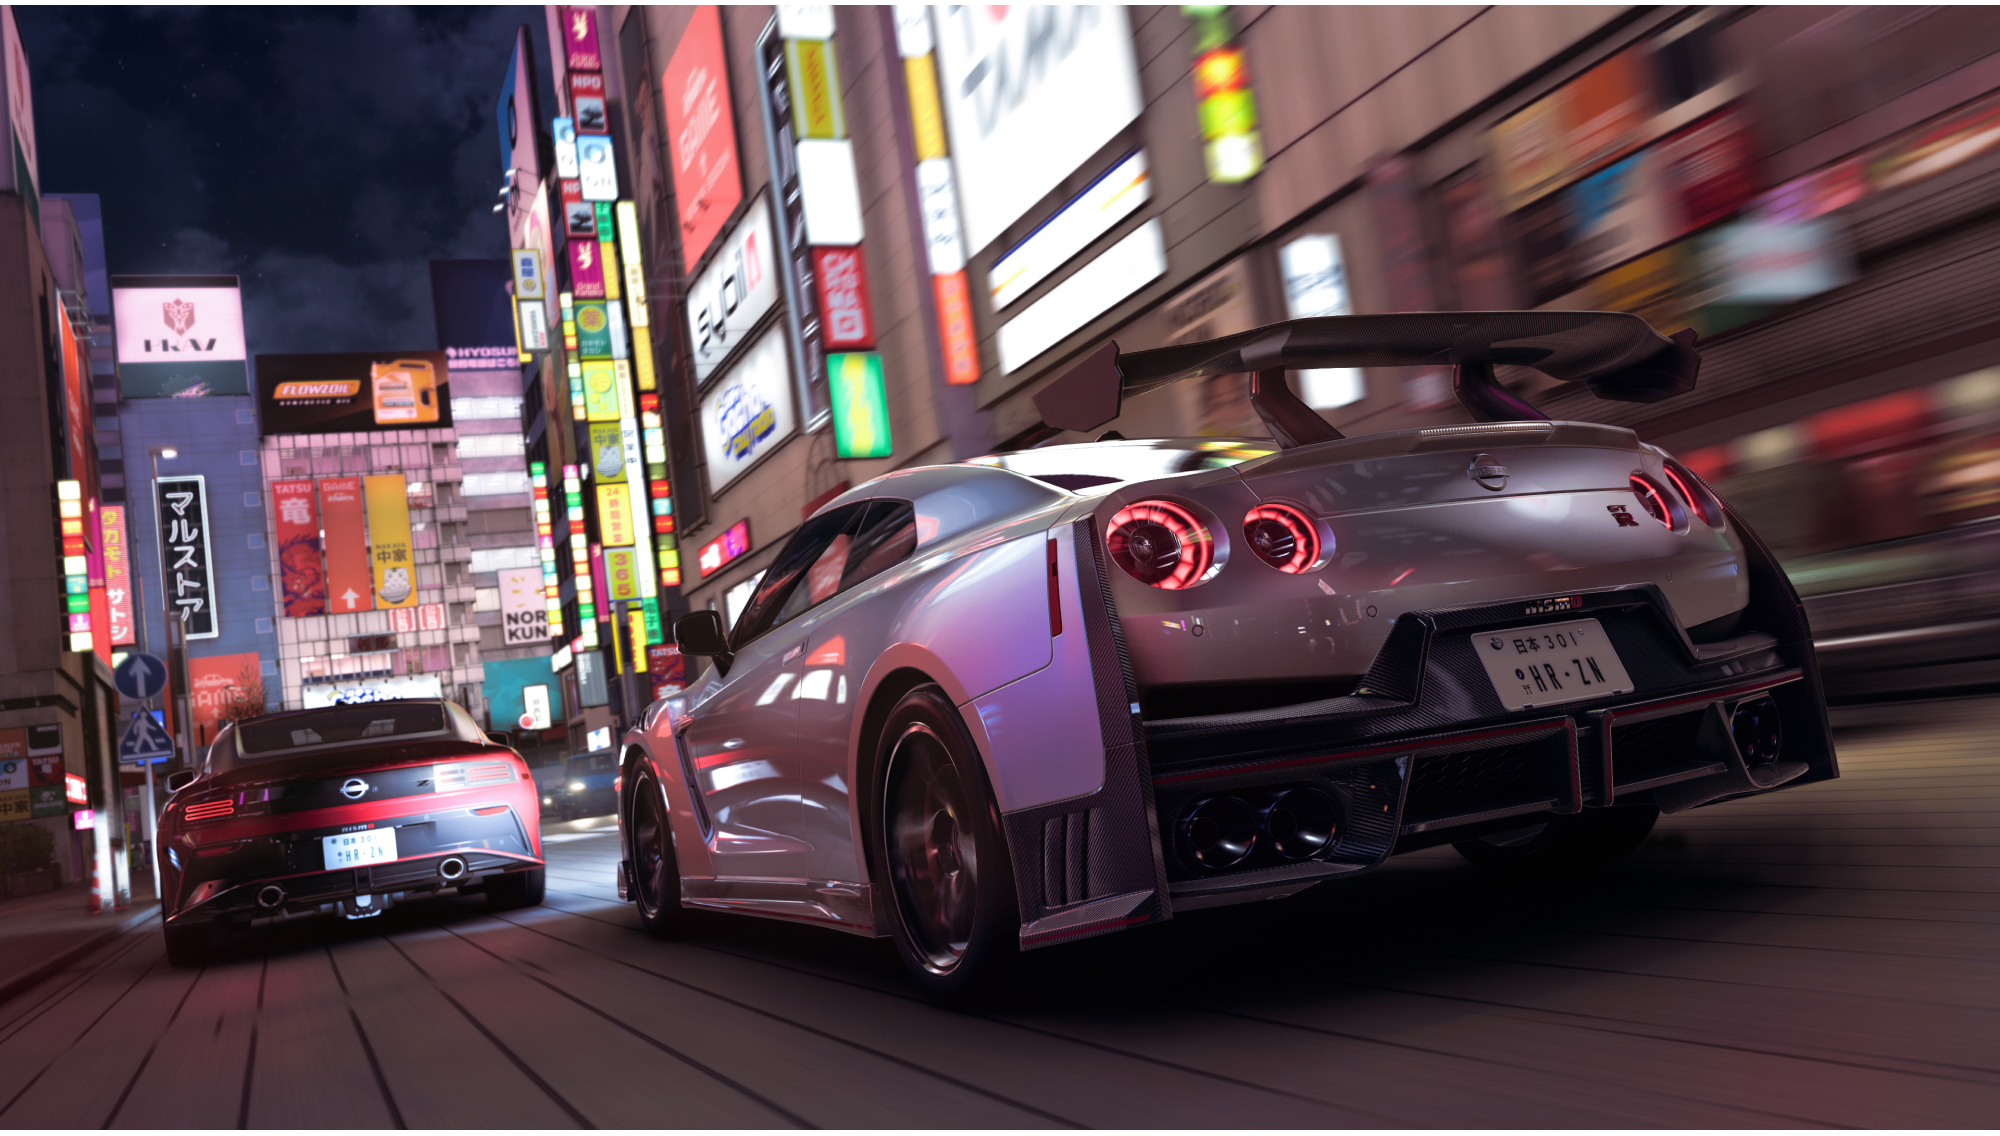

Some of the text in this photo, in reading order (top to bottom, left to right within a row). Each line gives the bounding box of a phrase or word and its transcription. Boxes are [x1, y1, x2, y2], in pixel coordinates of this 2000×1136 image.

[574, 289, 603, 297] Kaneko
[1470, 466, 1509, 478] NISSAN
[275, 483, 311, 494] TATSU
[323, 481, 356, 491] GAME
[375, 542, 406, 550] NAKAYA
[165, 491, 204, 622] マルストア
[377, 549, 408, 564] 中家
[101, 510, 128, 641] タカモト サトシ
[507, 610, 547, 625] NOR
[508, 625, 547, 641] KUN
[1513, 632, 1578, 654] 日本 301
[32, 757, 59, 766] TATSU
[343, 837, 357, 846] 日本
